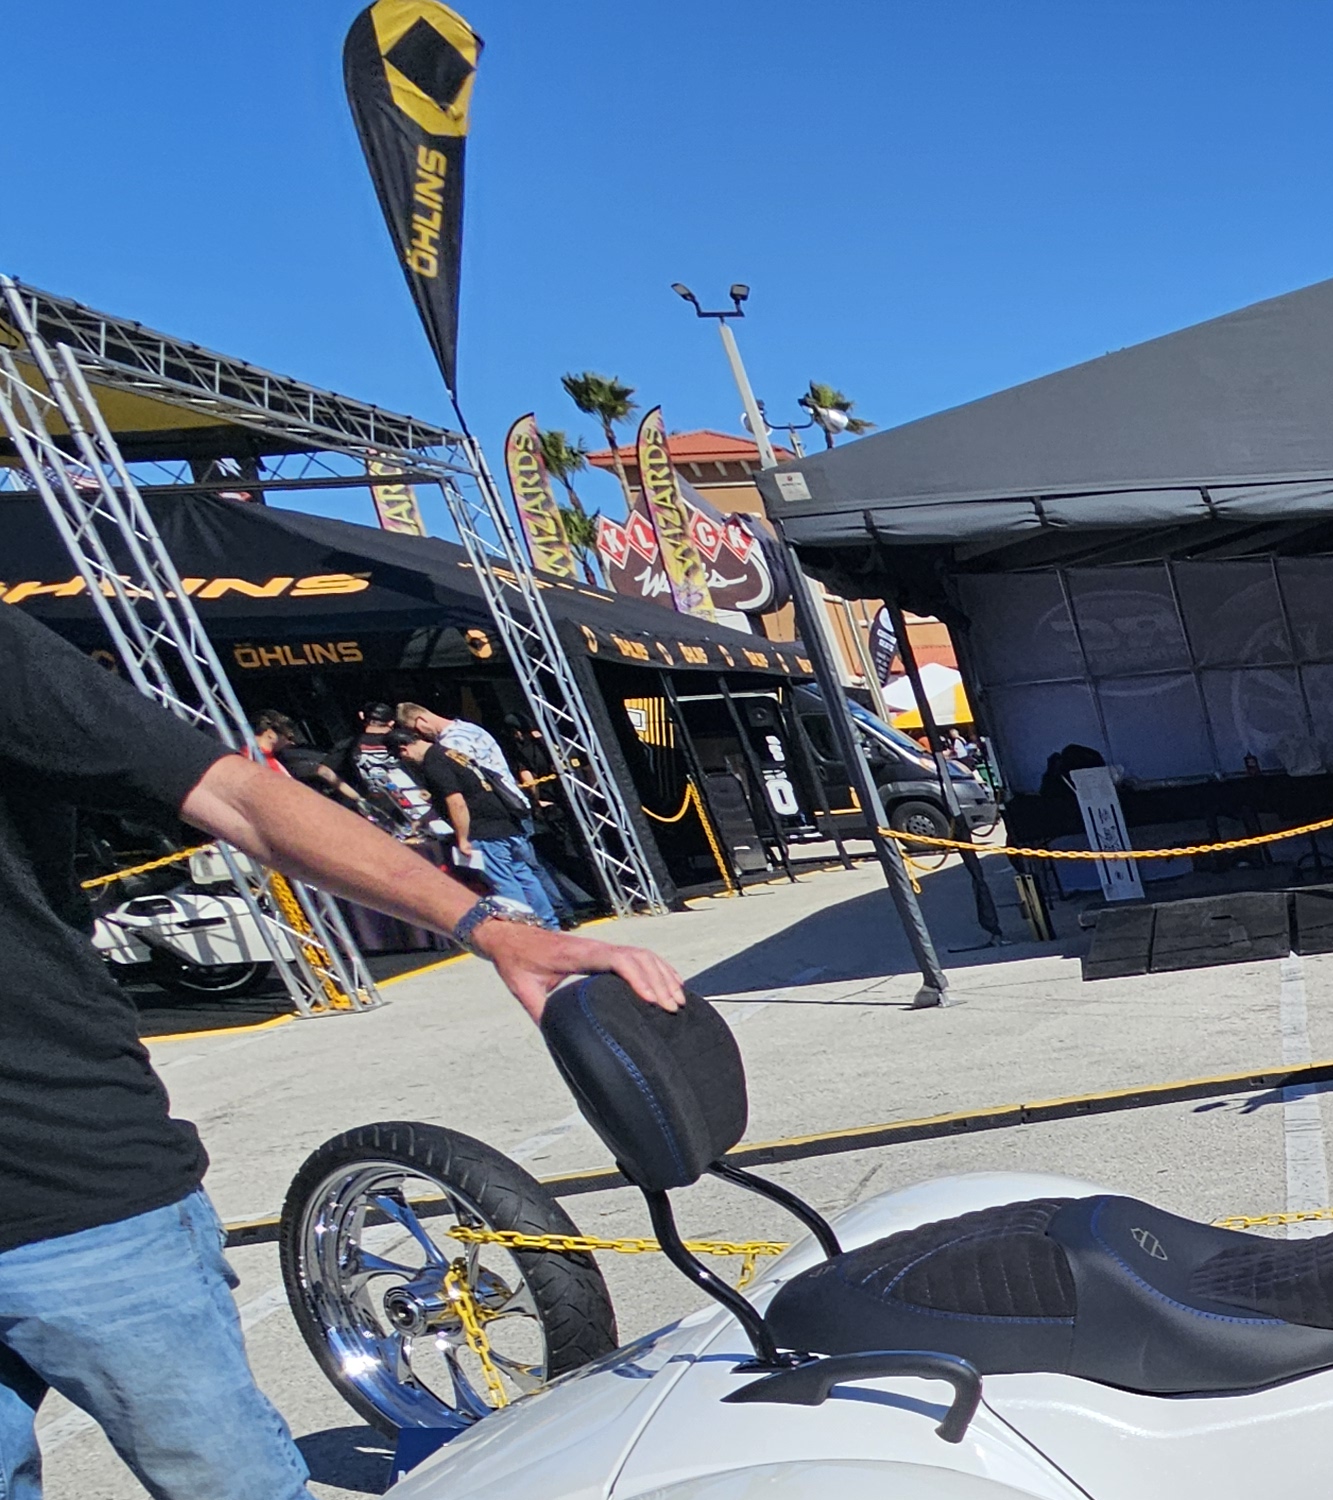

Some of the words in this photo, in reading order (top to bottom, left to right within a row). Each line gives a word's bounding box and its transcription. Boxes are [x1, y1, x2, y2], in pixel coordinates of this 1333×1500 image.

[406, 144, 448, 278] ÖHLINS
[513, 432, 570, 578] WIZARDS
[603, 521, 748, 554] KLCK
[645, 427, 694, 574] WIZARDS
[233, 641, 364, 669] ÖHLINS
